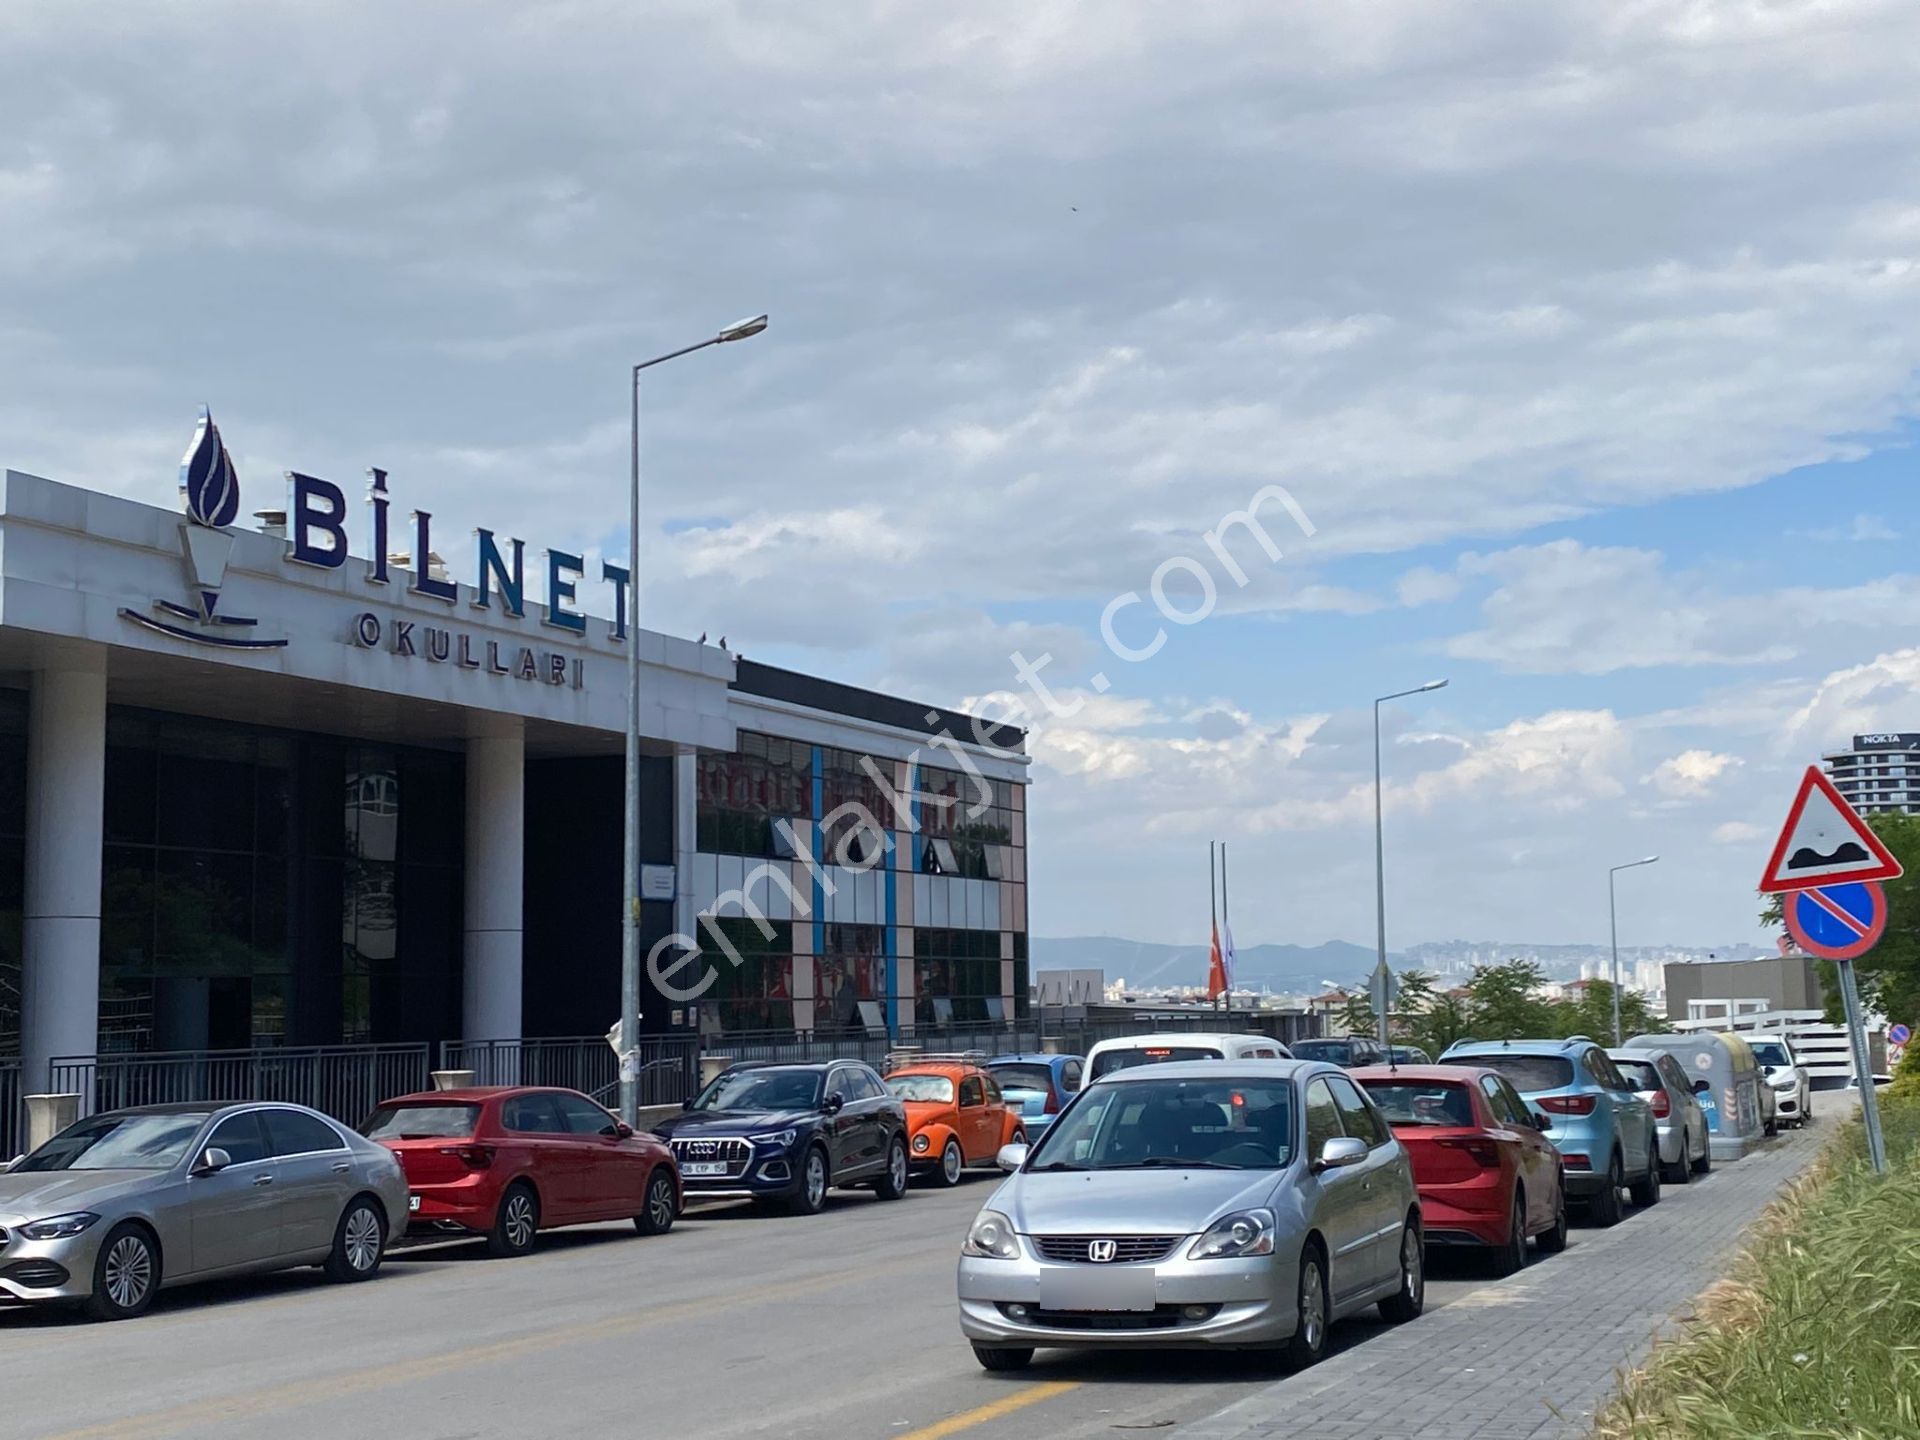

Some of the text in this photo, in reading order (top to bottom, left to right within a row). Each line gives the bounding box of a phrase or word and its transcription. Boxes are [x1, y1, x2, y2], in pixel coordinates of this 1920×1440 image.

[283, 466, 630, 641] BİLNET
[353, 612, 584, 690] OKULLARI
[1863, 734, 1901, 744] NOKTA
